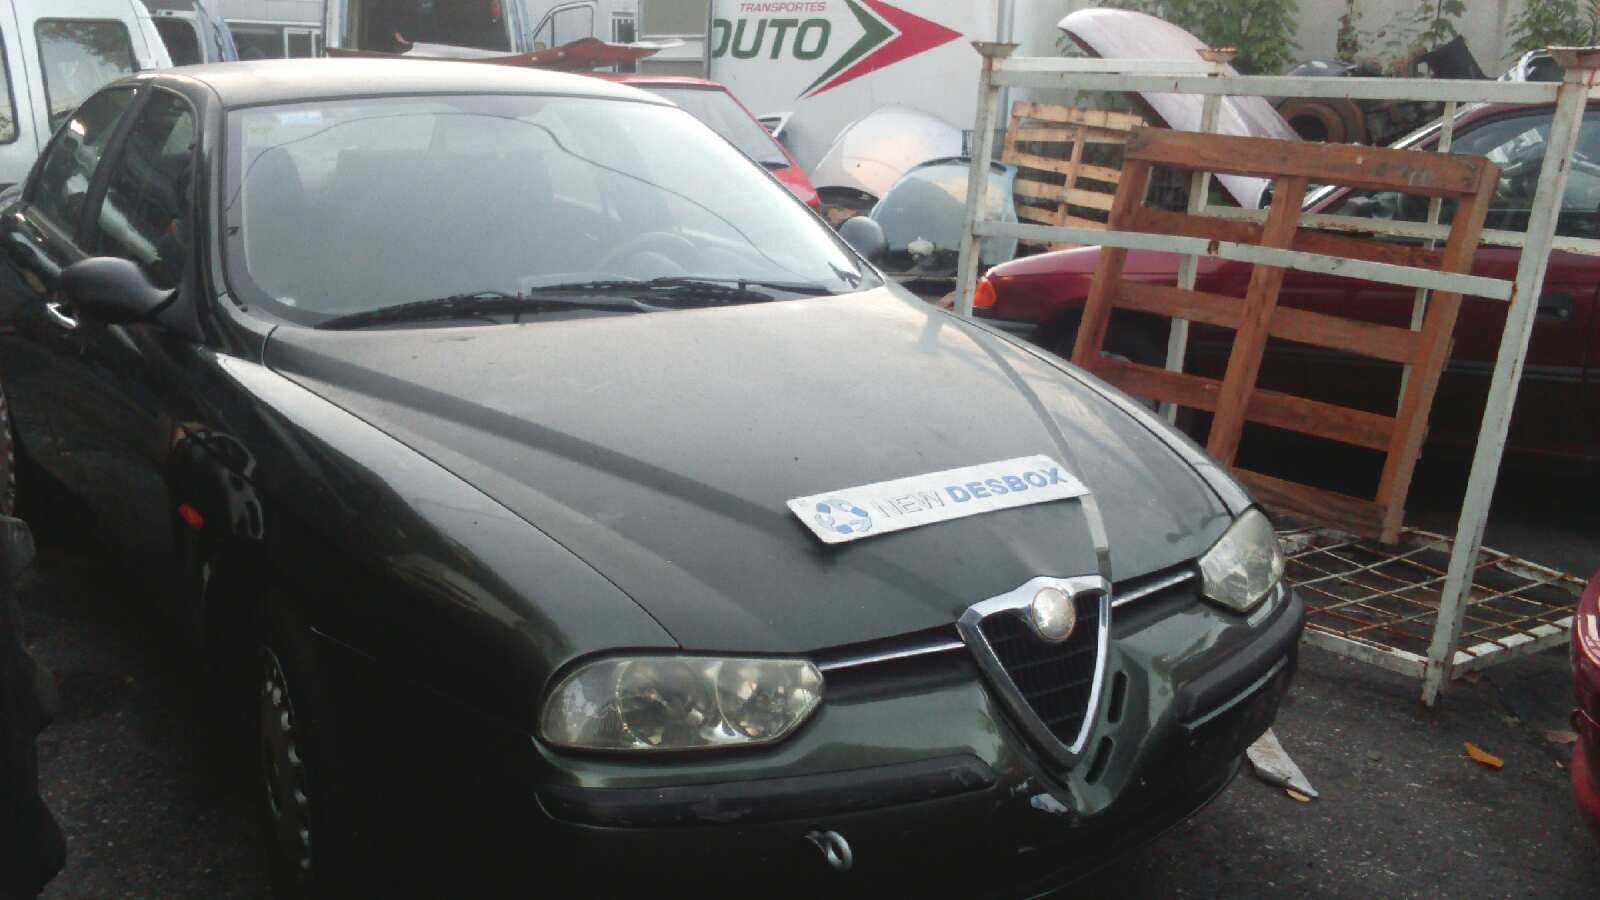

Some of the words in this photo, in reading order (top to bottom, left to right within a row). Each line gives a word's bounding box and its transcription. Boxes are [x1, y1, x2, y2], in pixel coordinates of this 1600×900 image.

[740, 1, 826, 12] TRANSPORTES
[870, 488, 946, 518] NEW
[943, 467, 1068, 502] DESBOX
